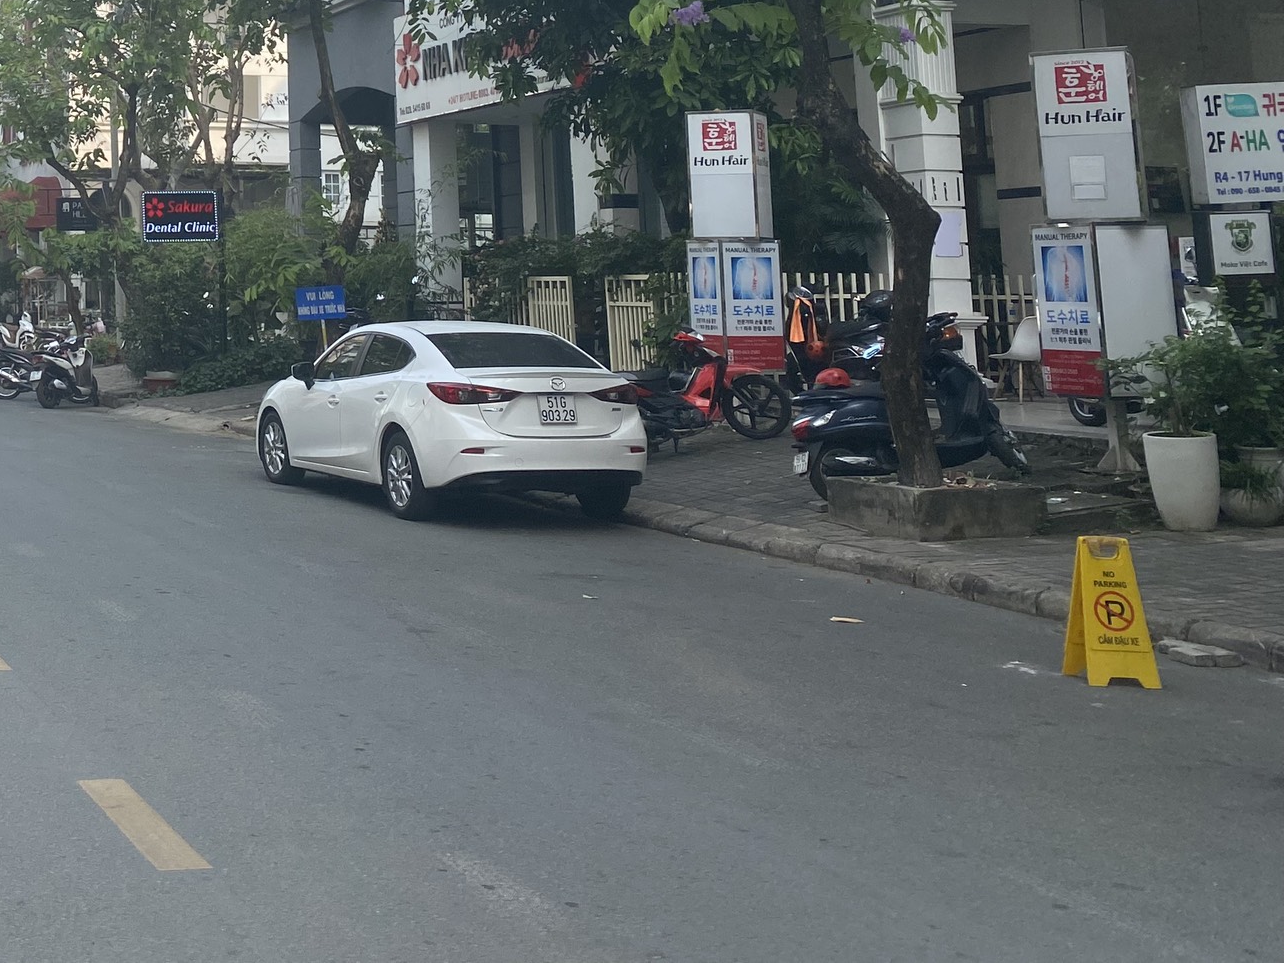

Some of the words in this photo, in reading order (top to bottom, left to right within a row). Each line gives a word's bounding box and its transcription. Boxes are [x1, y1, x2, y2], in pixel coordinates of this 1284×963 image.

[422, 43, 453, 81] NHA
[1204, 94, 1222, 117] 1F
[1045, 112, 1081, 125] Hun
[1086, 108, 1126, 123] Hair
[1207, 131, 1226, 153] 2F
[1231, 129, 1270, 153] A-HA
[694, 156, 719, 167] Hun
[722, 154, 749, 166] Hair
[1214, 172, 1229, 183] R4
[1237, 171, 1250, 182] 17
[1253, 170, 1283, 183] Hung
[167, 201, 213, 213] Sakura
[146, 222, 182, 233] Dental
[184, 221, 216, 233] Clinic
[1035, 233, 1059, 241] MANUAL
[694, 304, 718, 316] 도수치료
[733, 304, 775, 317] 도수치료
[1047, 309, 1091, 325] 도수치료
[547, 397, 567, 409] 51G
[541, 409, 576, 422] 903.29
[1094, 580, 1127, 588] PARKING
[1131, 638, 1140, 646] XE
